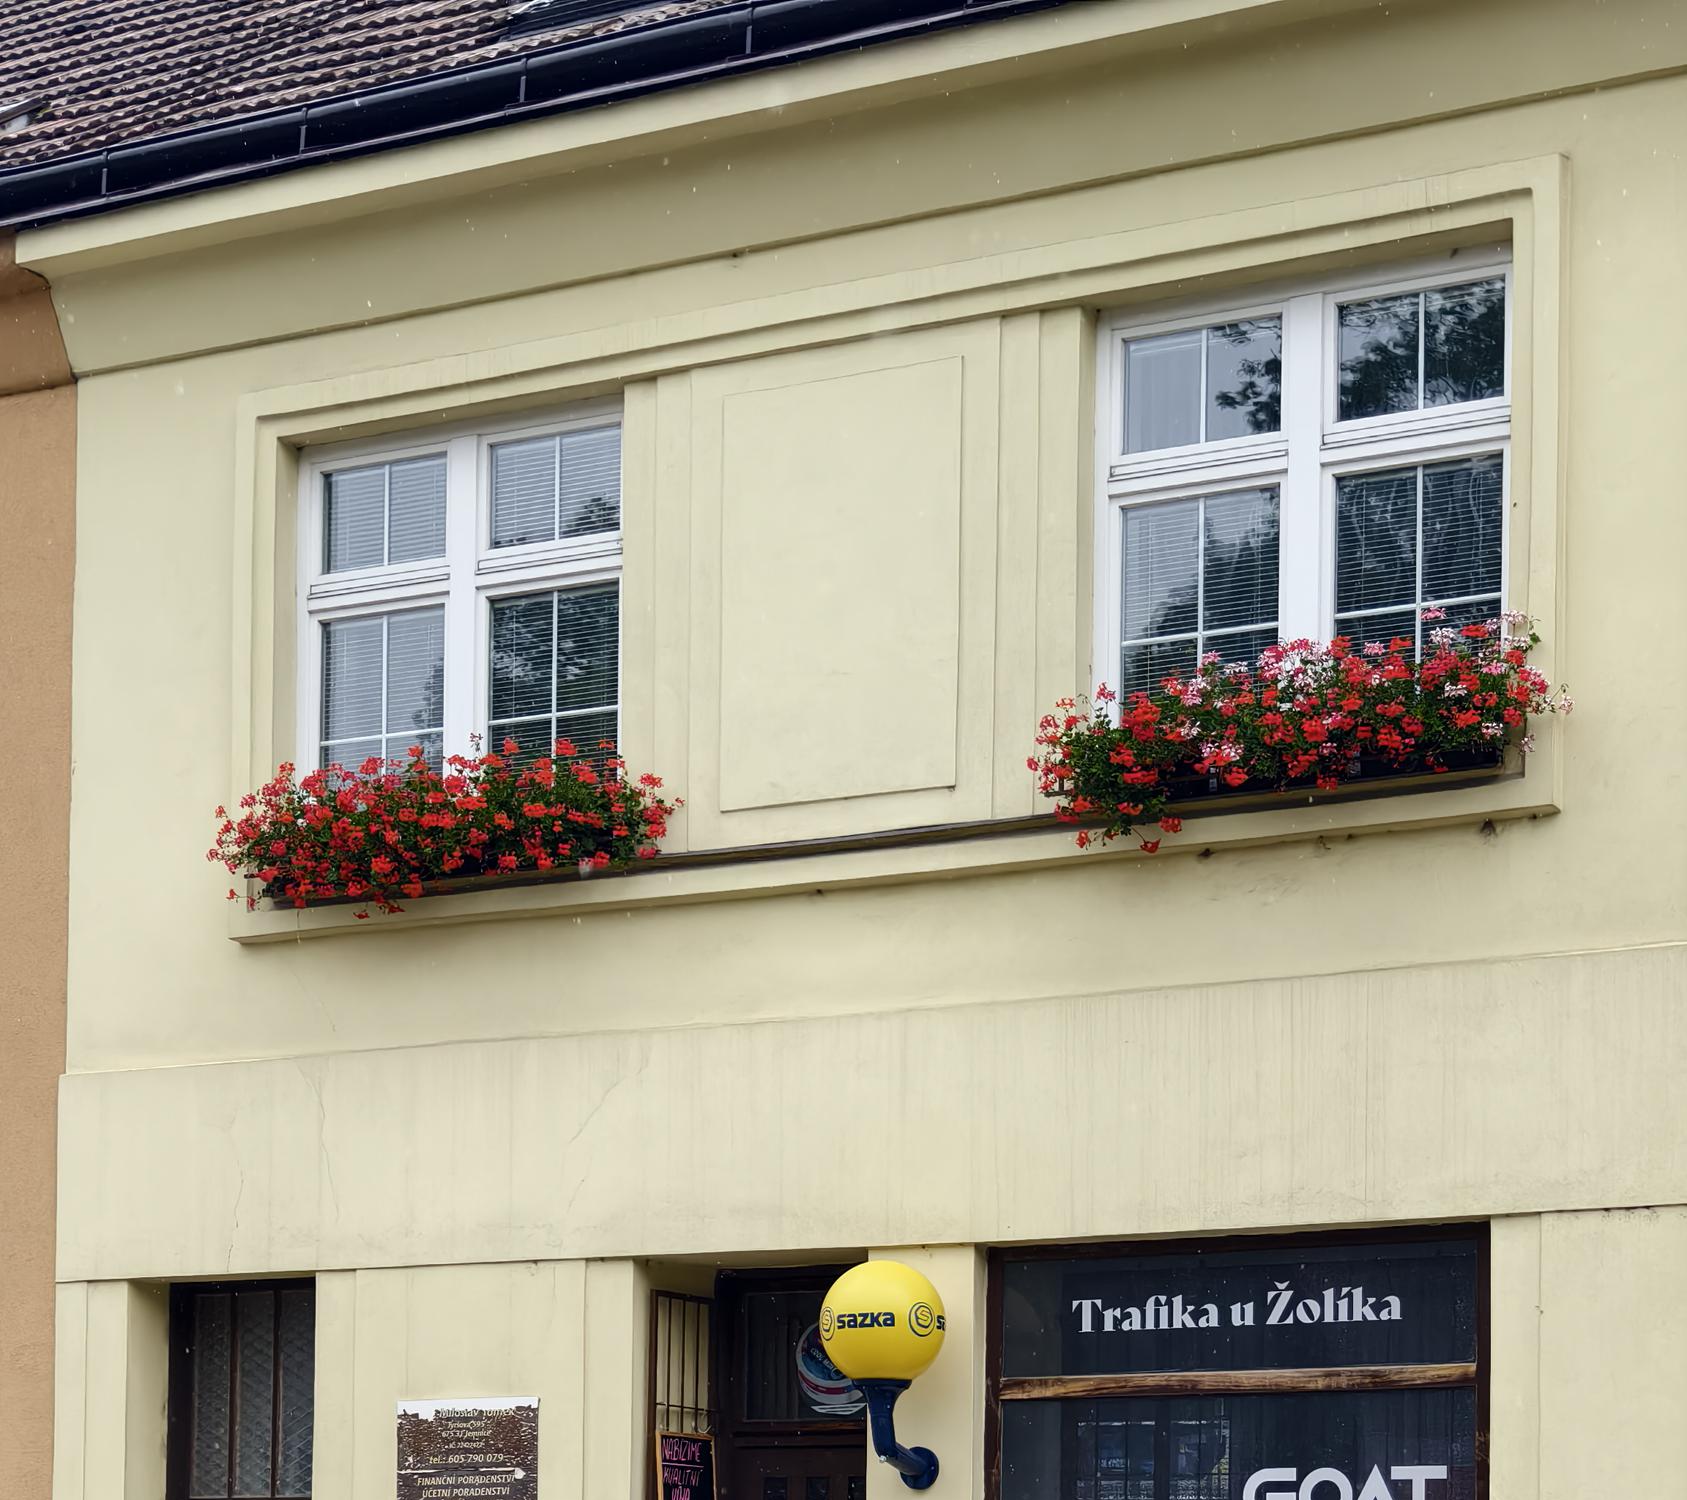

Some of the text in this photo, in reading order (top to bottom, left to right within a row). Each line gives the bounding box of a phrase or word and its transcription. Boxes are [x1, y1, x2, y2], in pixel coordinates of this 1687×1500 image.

[1072, 1280, 1402, 1333] Trafika u Žolíka
[836, 1311, 896, 1330] sazka
[448, 1454, 464, 1464] 605
[466, 1454, 484, 1463] 790
[486, 1453, 504, 1463] 079
[417, 1475, 456, 1486] FINANČNÍ
[422, 1485, 510, 1498] ÚČETNÍ PORADENSTVÍ
